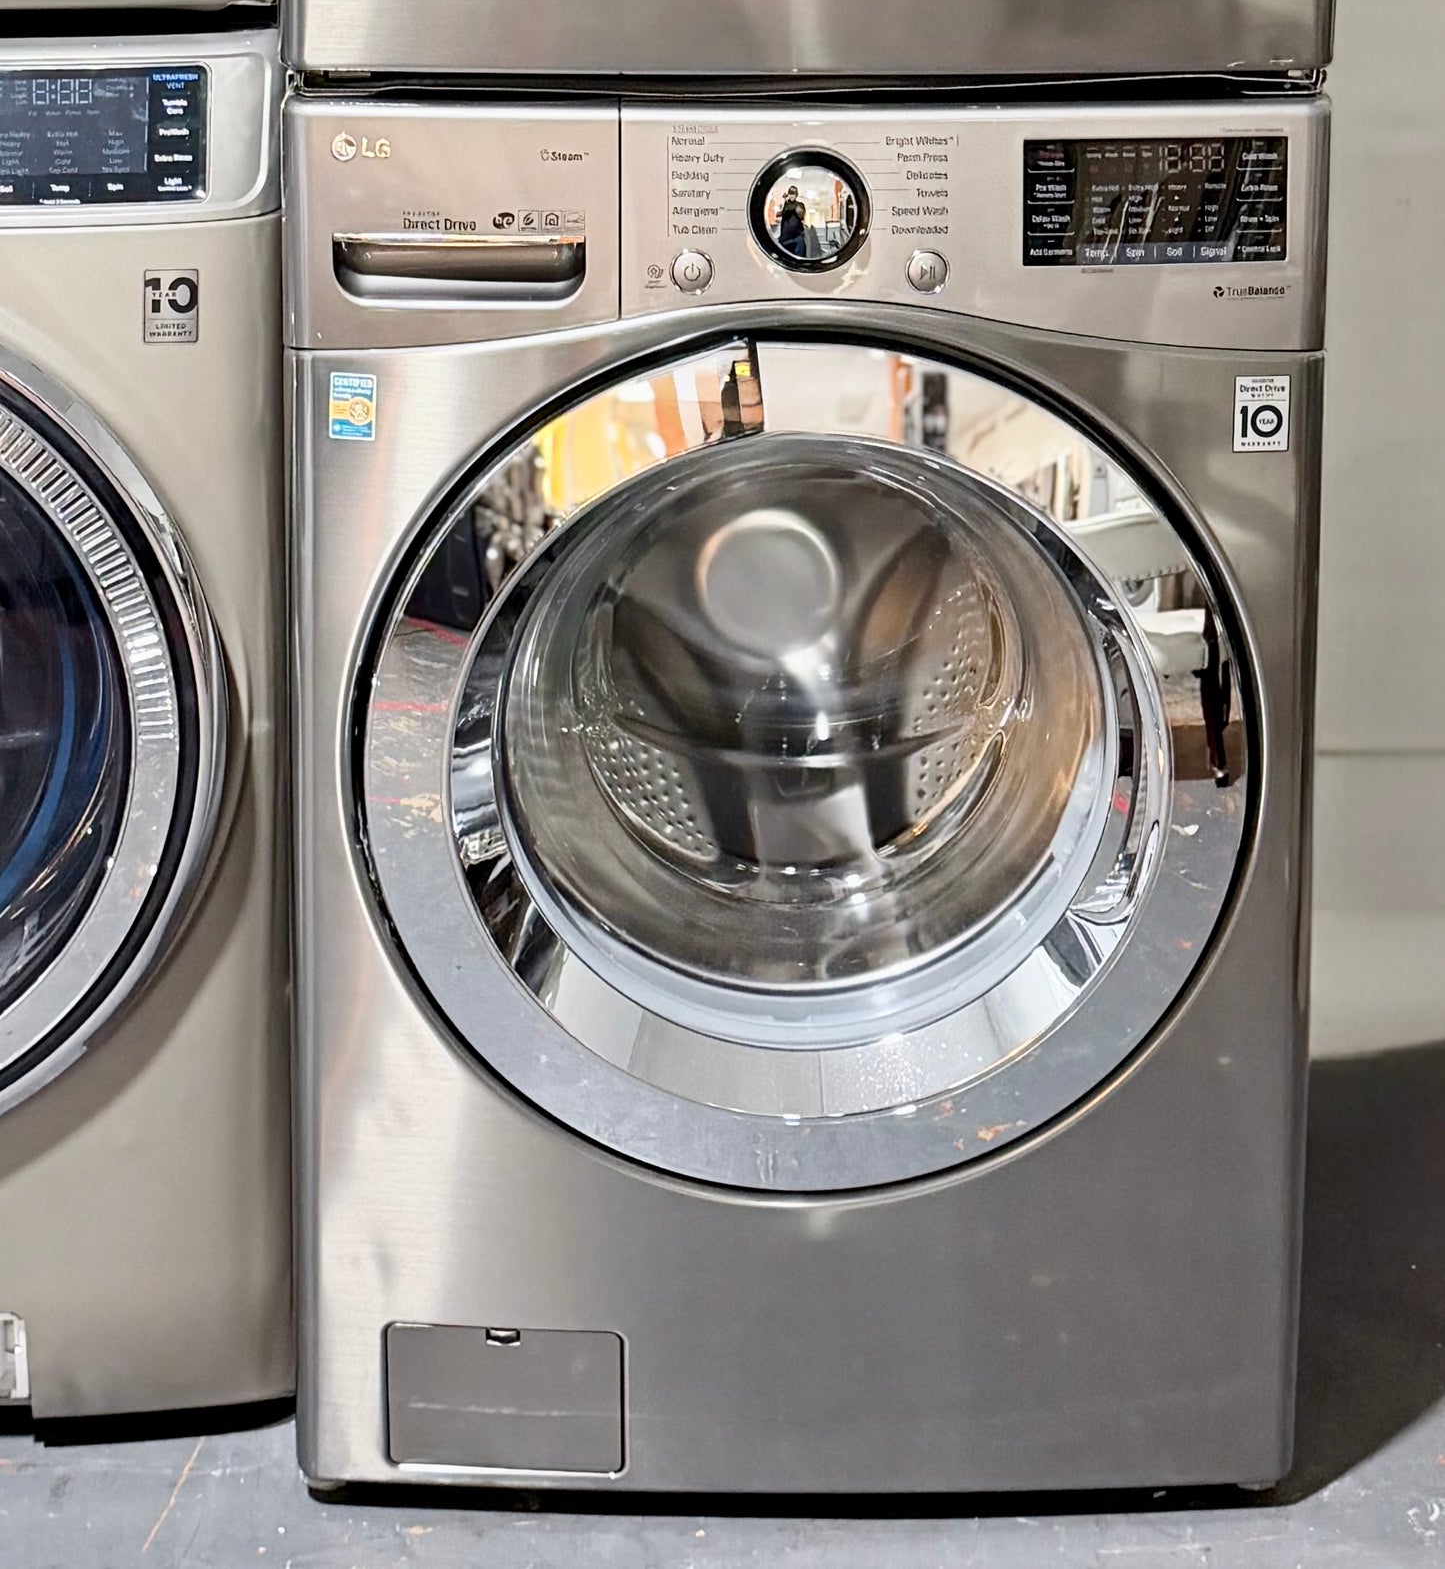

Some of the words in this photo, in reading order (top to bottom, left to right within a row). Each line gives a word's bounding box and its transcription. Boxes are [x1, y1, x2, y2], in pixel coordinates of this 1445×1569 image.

[671, 136, 705, 146] Normal
[885, 136, 914, 148] Bright
[361, 137, 391, 158] LG
[671, 154, 700, 164] Heavy
[703, 153, 724, 164] Duty
[923, 152, 948, 162] Press
[671, 171, 709, 182] Bedding
[672, 189, 711, 199] Sanitary
[892, 206, 920, 217] Speed
[922, 206, 949, 216] Wash
[403, 217, 440, 230] Direct
[445, 218, 477, 231] Drive
[673, 225, 689, 235] Tub
[691, 225, 718, 235] Clean
[892, 225, 949, 235] Downloaded
[1200, 246, 1227, 257] Signal
[145, 277, 198, 314] 10
[1240, 384, 1263, 393] Direct
[1264, 384, 1286, 392] Drive
[1240, 404, 1283, 438] 10
